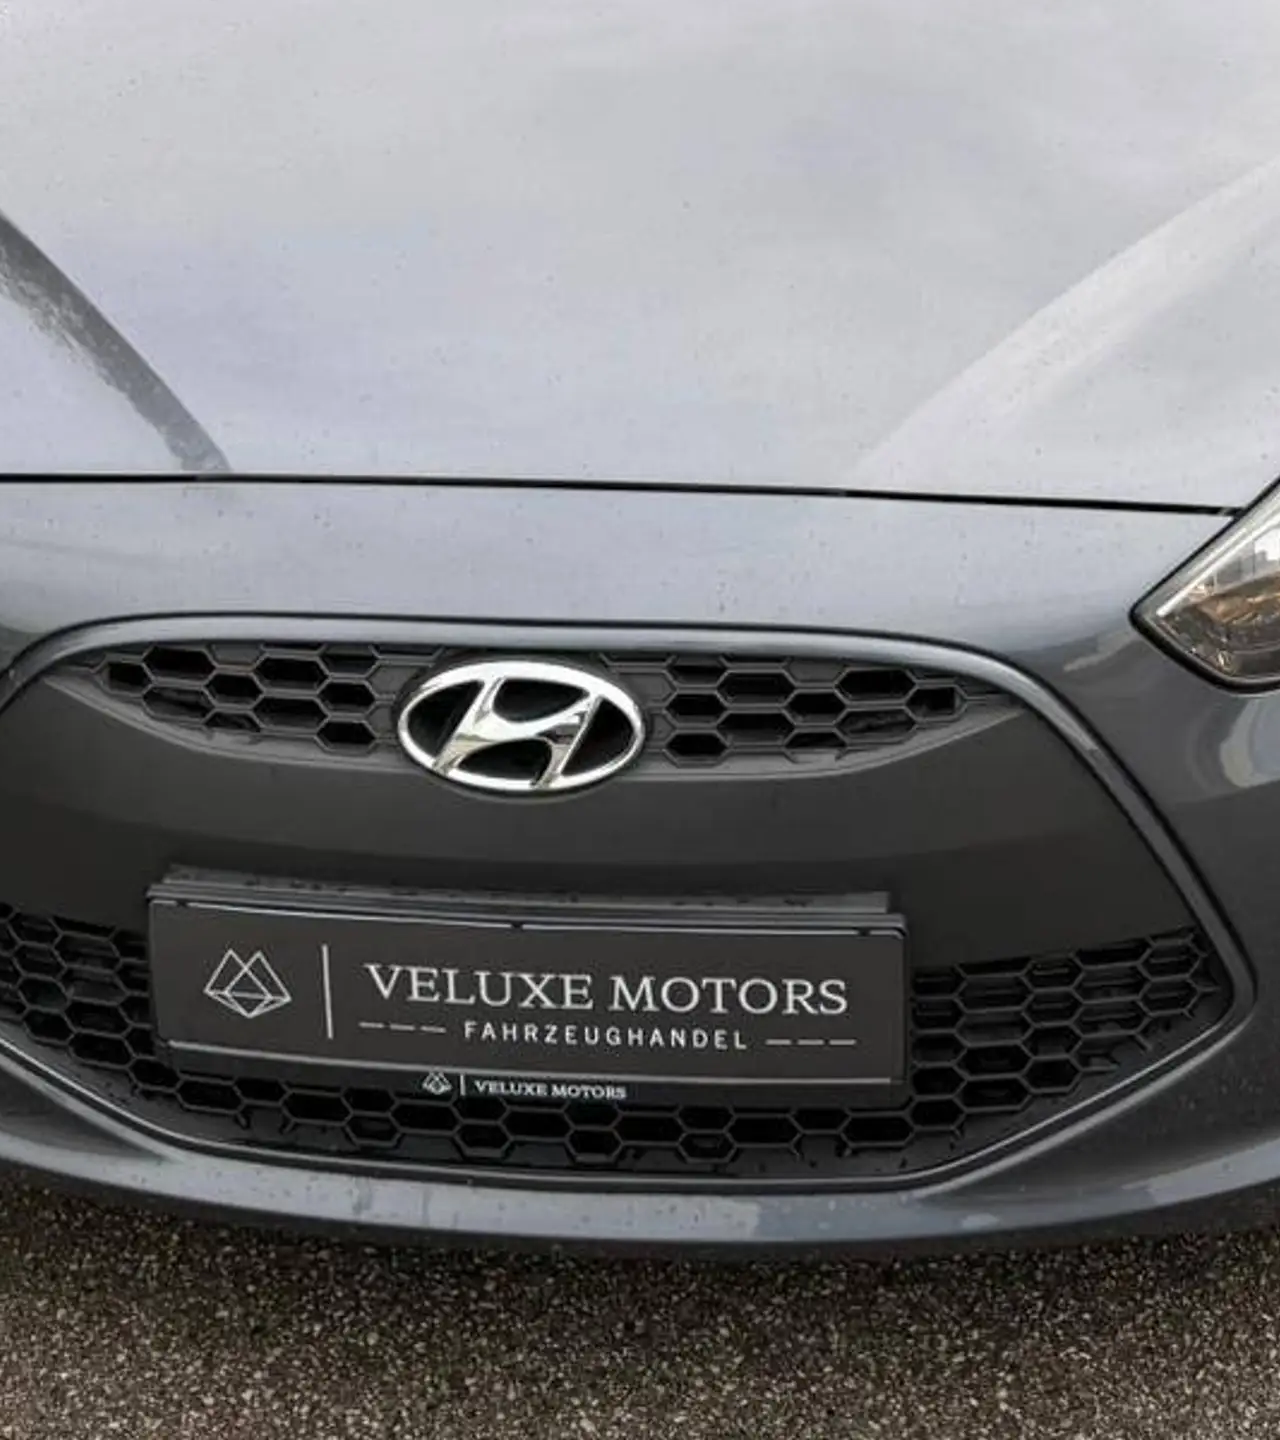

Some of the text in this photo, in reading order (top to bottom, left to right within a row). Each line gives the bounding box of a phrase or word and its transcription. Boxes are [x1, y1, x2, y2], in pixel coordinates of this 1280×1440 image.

[364, 963, 849, 1016] VELUXE MOTORS
[463, 1019, 748, 1051] FAHRZEUGHANDEL
[473, 1079, 628, 1101] VELUXE MOTORS
